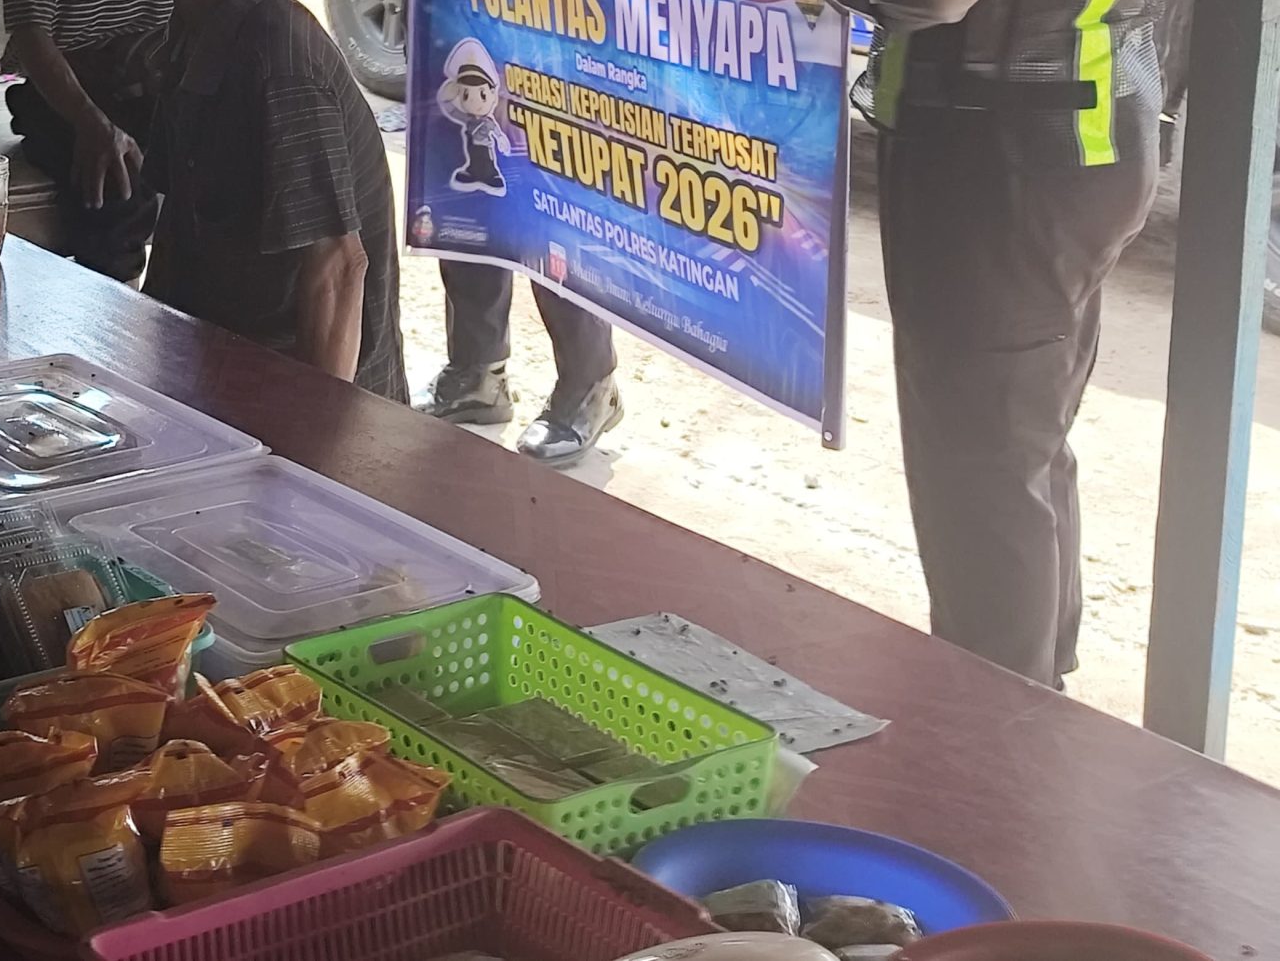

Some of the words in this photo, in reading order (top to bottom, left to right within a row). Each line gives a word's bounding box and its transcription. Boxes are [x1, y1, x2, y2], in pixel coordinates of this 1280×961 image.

[505, 63, 568, 112] OPERASI
[570, 83, 666, 146] KEPOLISIAN
[670, 114, 778, 181] TERPUSAT
[575, 52, 606, 77] Dalam
[607, 63, 647, 92] Rangka
[533, 188, 603, 239] SATLANTAS
[605, 221, 656, 262] POLRES
[658, 243, 740, 302] KATINGAN
[654, 156, 783, 252] 2026"
